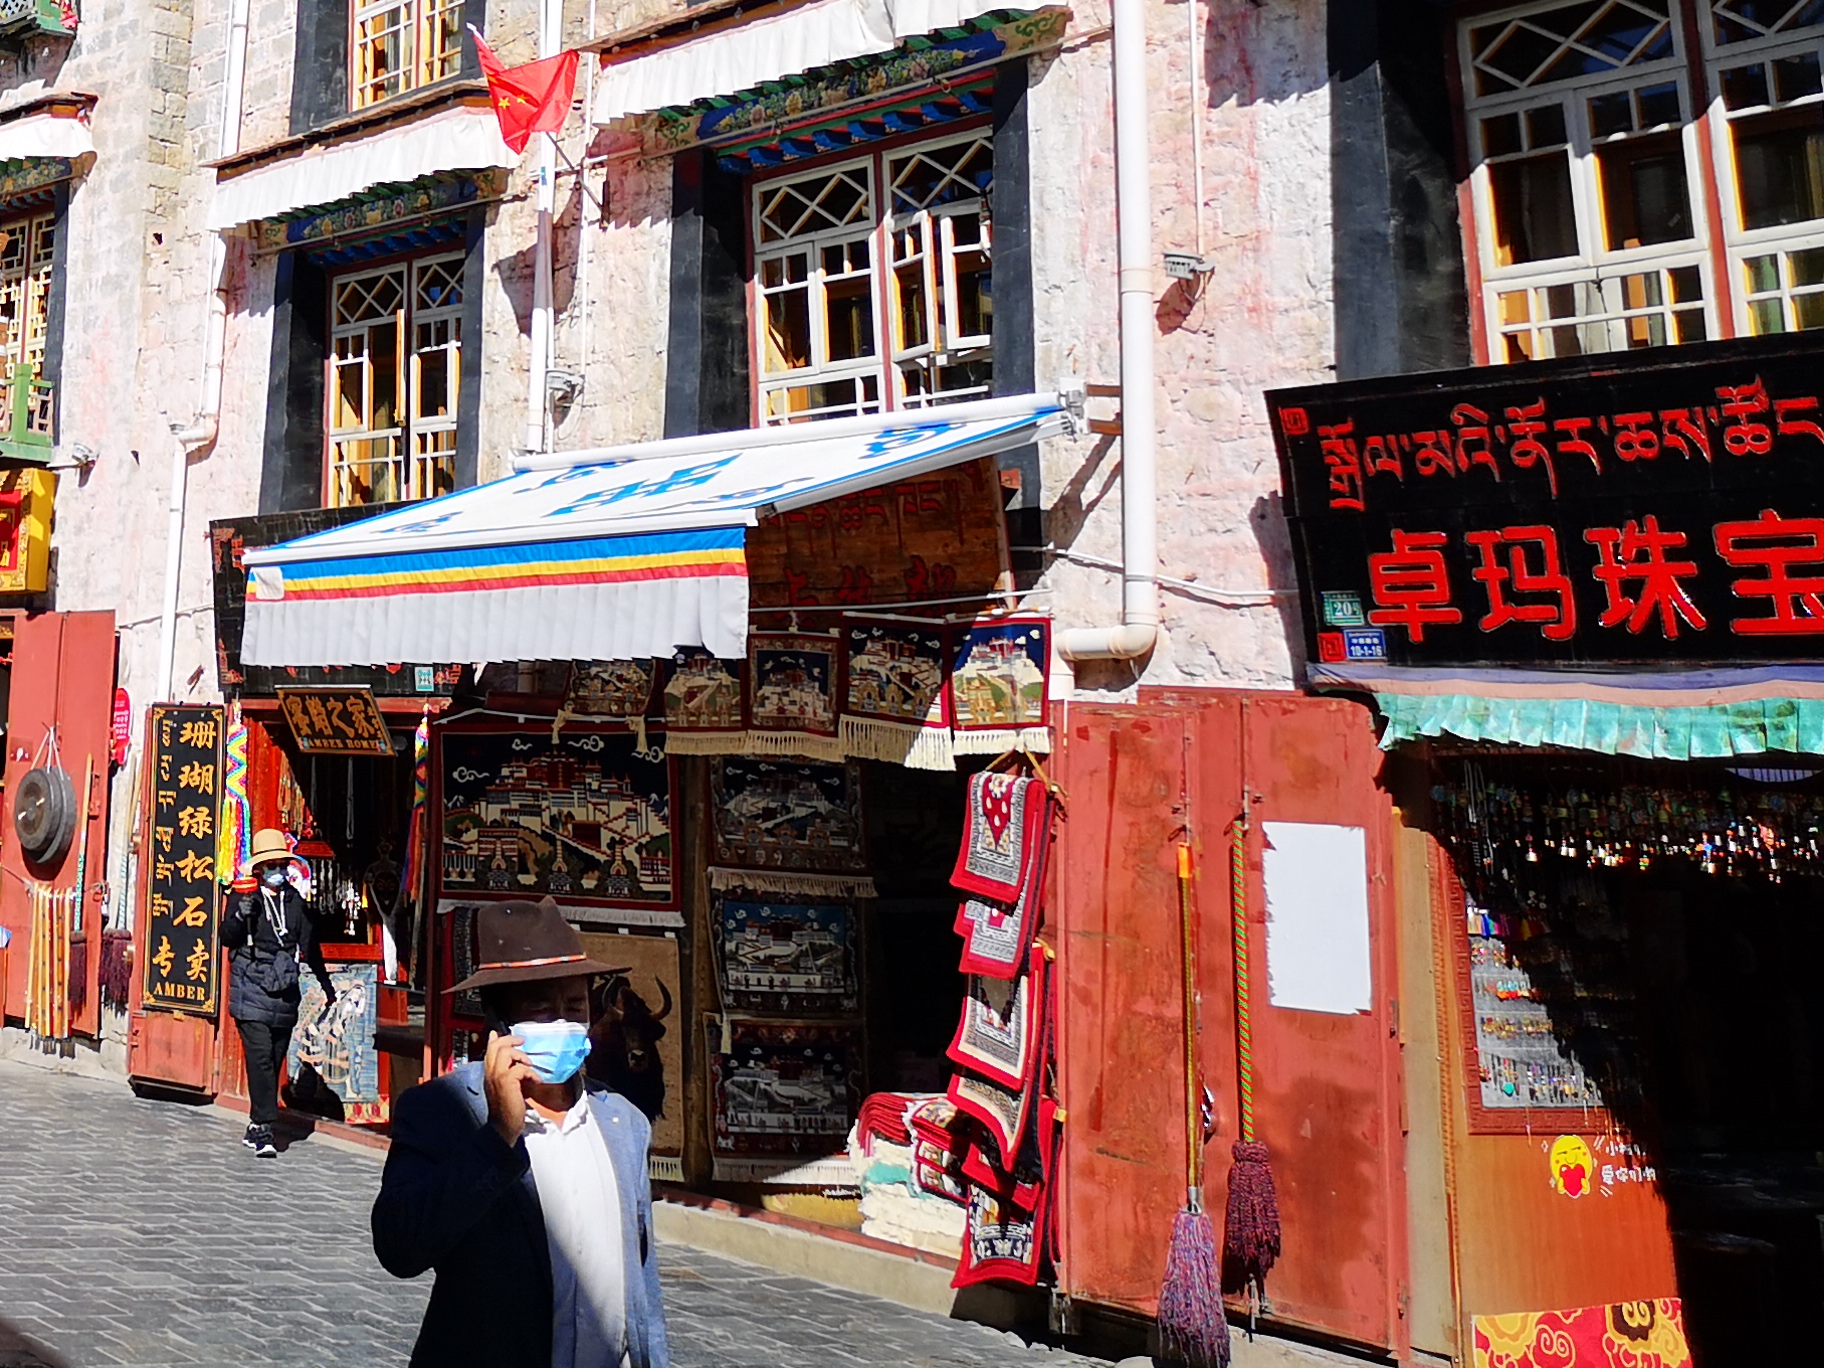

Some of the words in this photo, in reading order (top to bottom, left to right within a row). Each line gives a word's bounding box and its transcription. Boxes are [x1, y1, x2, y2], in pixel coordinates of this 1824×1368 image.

[1367, 508, 1824, 643] 卓玛珠宝
[153, 982, 205, 1002] AMBER
